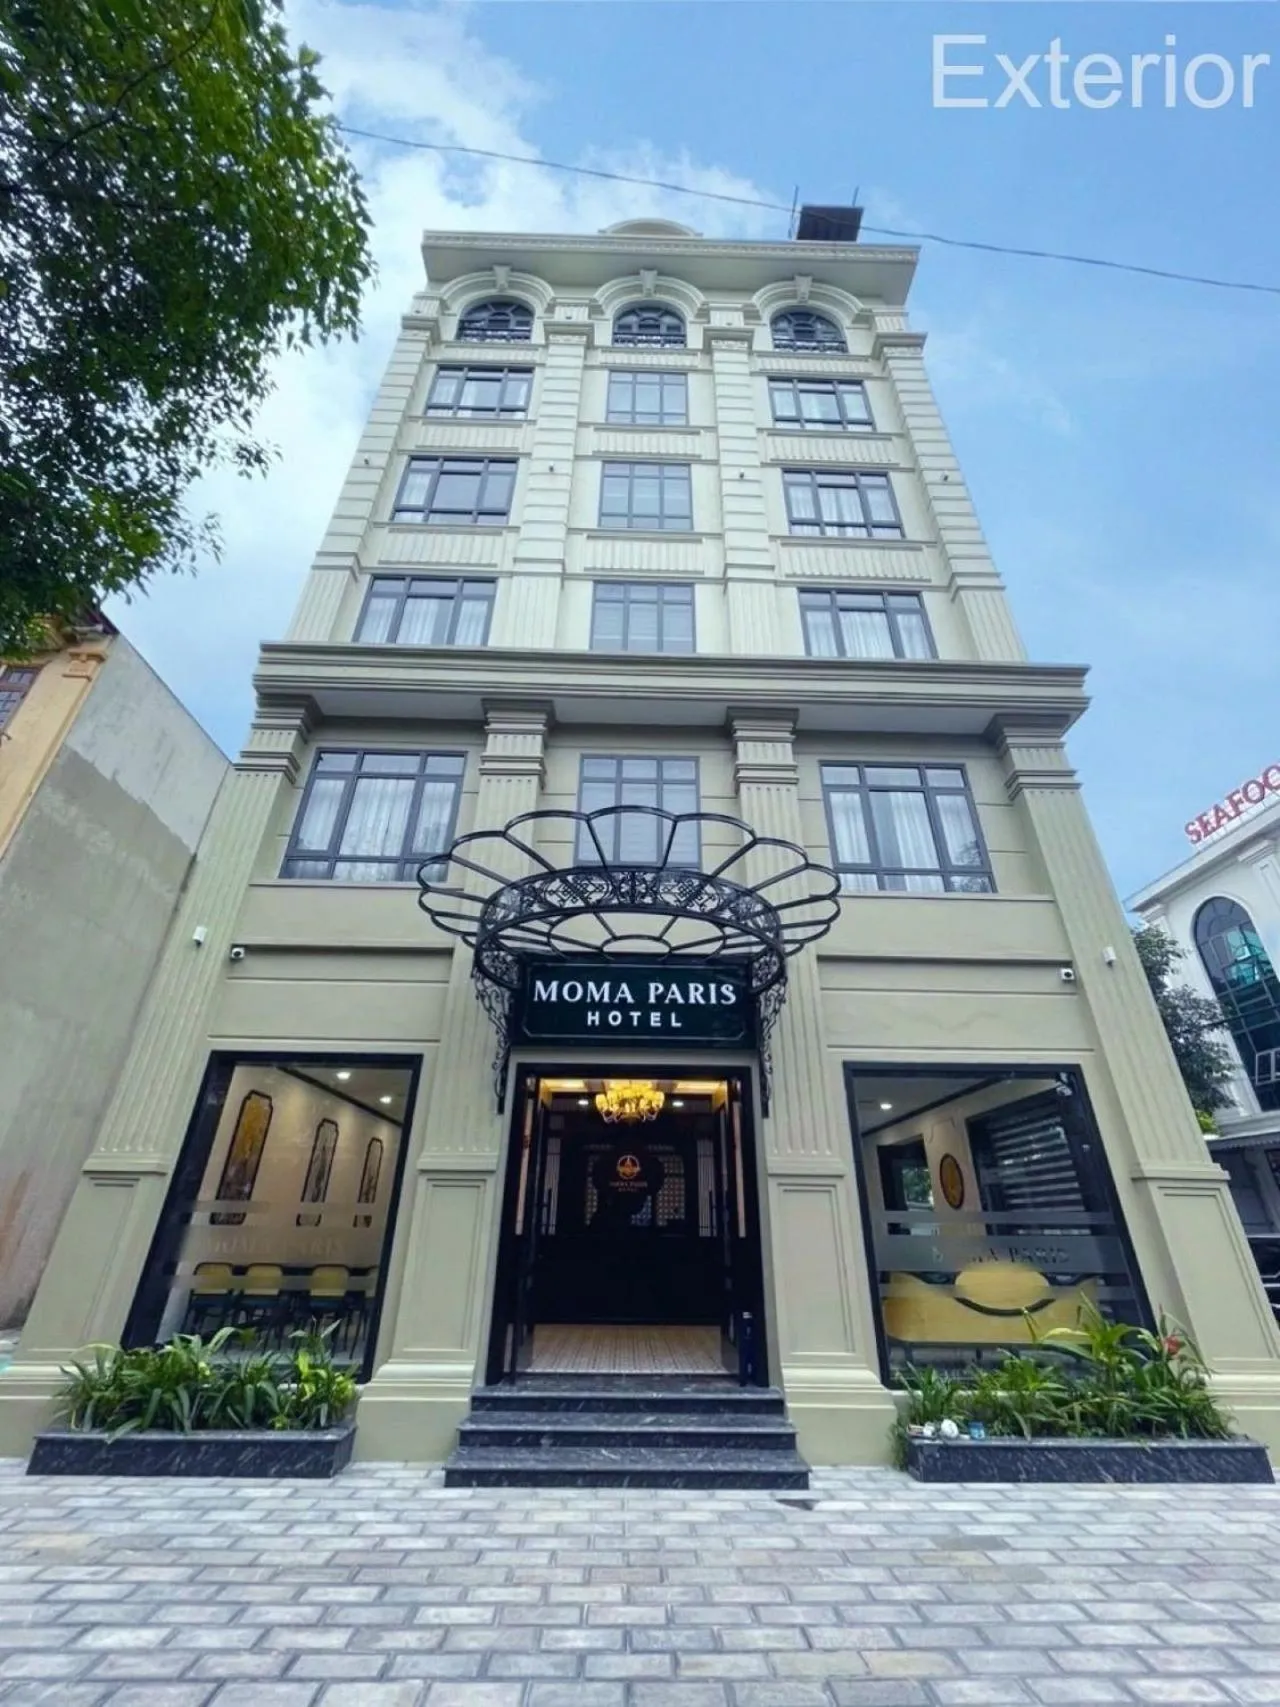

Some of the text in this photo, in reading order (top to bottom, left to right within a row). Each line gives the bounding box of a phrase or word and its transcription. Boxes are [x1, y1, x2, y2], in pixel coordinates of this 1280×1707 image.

[533, 980, 737, 1005] MOMA PARIS
[587, 1011, 682, 1028] HOTEL
